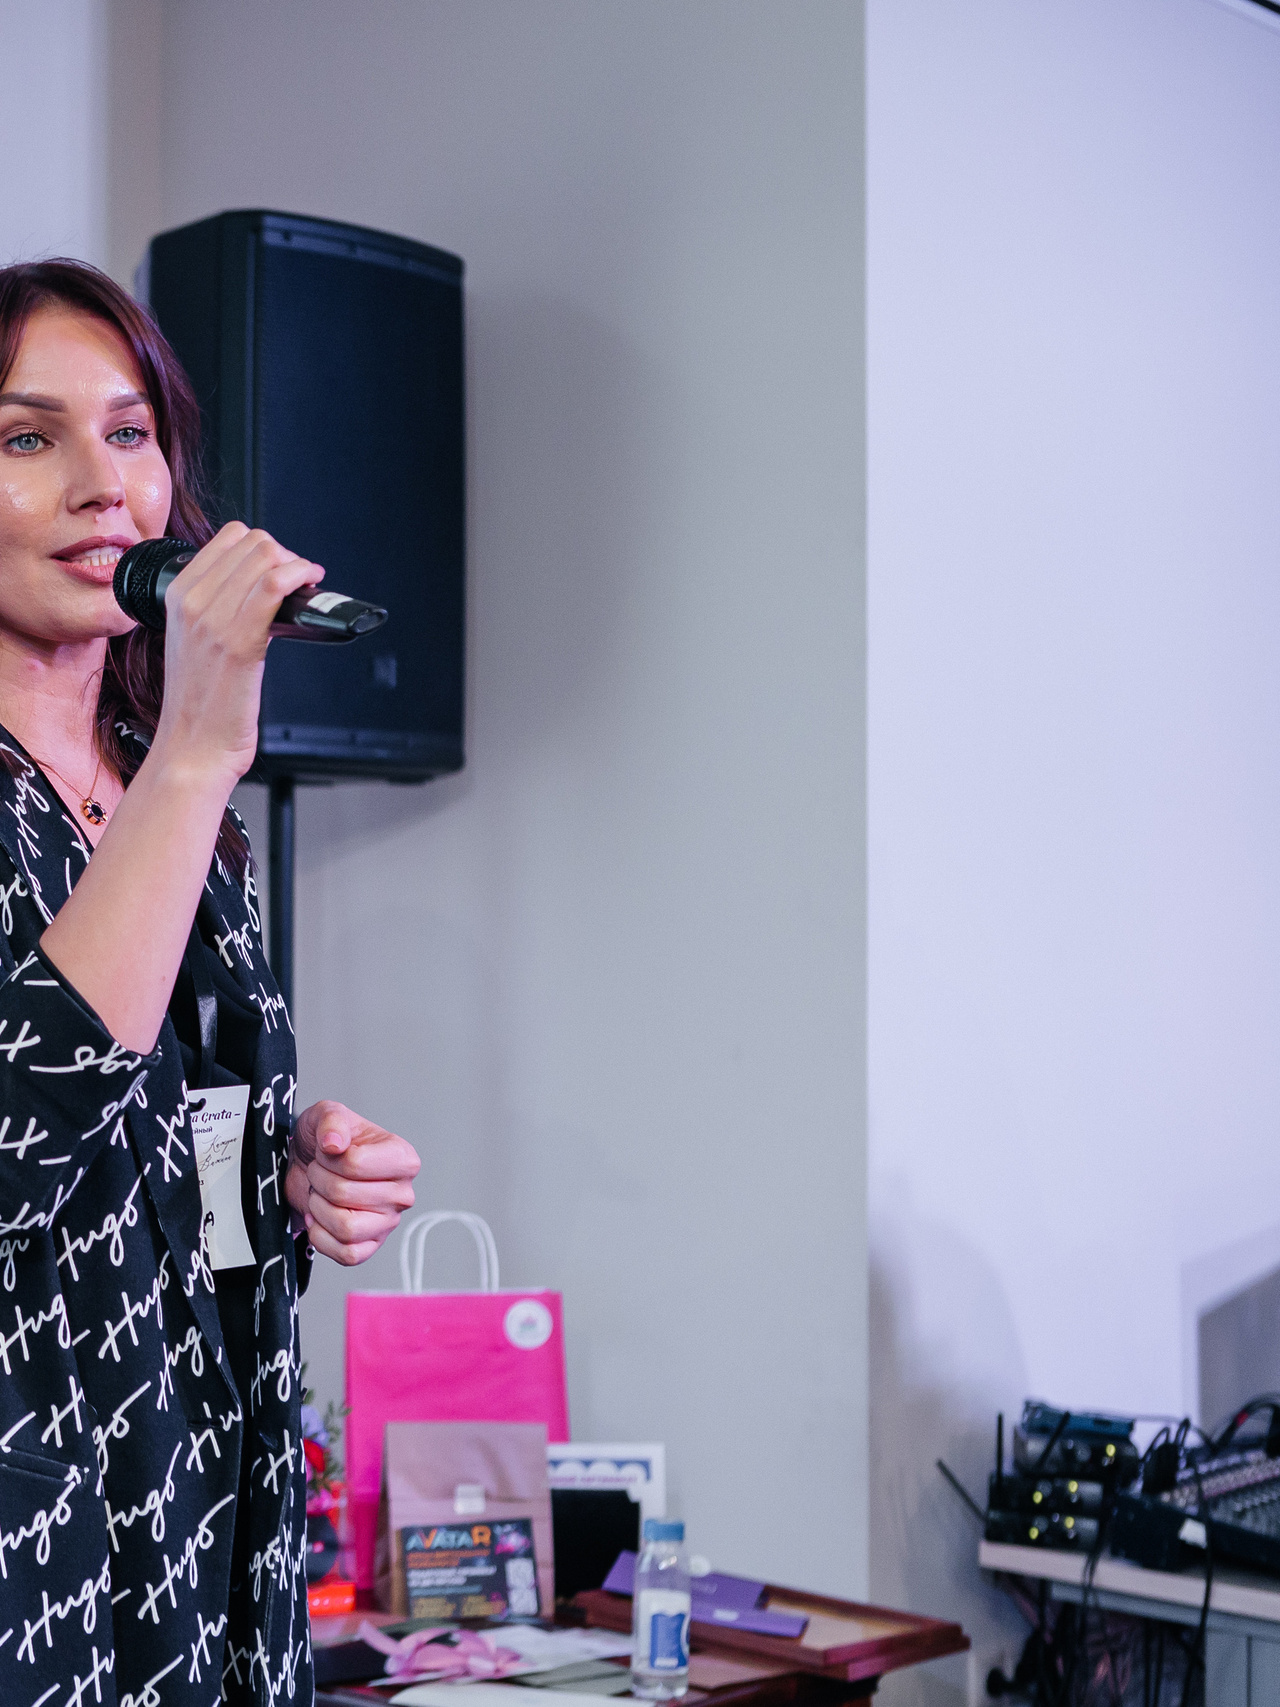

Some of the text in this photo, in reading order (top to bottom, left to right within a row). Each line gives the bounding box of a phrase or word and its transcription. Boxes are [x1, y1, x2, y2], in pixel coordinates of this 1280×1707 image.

[201, 1109, 232, 1124] Grata
[17, 1552, 111, 1664] Hugo
[138, 1492, 235, 1624] Hugo
